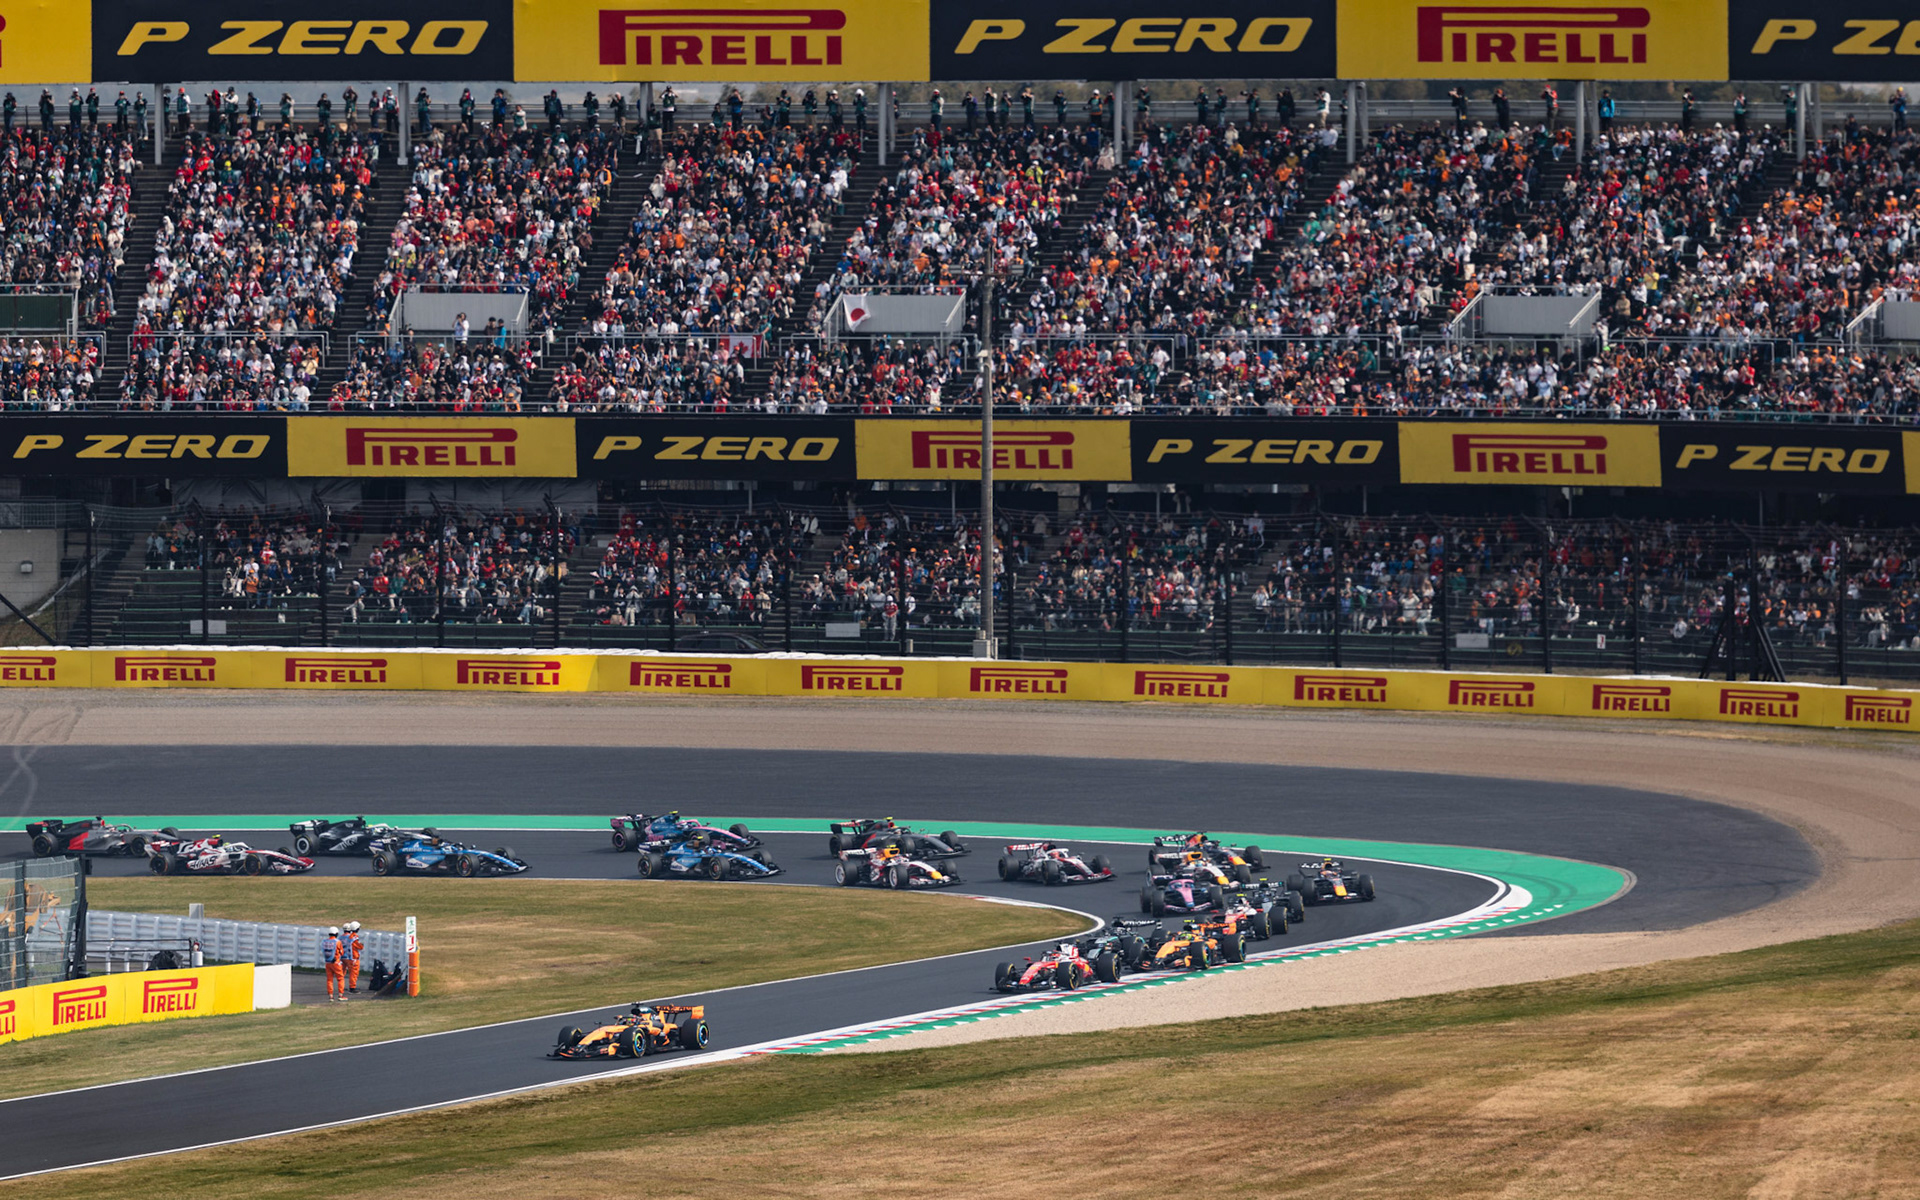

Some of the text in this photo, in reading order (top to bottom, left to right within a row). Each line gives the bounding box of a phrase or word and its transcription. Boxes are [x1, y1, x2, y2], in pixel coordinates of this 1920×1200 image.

[117, 20, 490, 57] P ZERO
[599, 10, 847, 66] PIRELLI
[954, 17, 1314, 55] P ZERO
[1417, 6, 1650, 64] PIRELLI
[1751, 19, 1818, 55] P
[13, 435, 271, 460] P ZERO
[346, 428, 519, 467] PIRELLI
[593, 437, 840, 462] P ZERO
[911, 431, 1076, 470] PIRELLI
[1147, 440, 1384, 465] P ZERO
[1452, 433, 1608, 474] PIRELLI
[1676, 445, 1891, 474] P ZERO
[115, 657, 217, 683] PIRELLI
[285, 658, 388, 683] PIRELLI
[457, 660, 561, 686] PIRELLI
[630, 662, 733, 689] PIRELLI
[801, 665, 904, 691] PIRELLI
[970, 667, 1069, 694] PIRELLI
[1135, 671, 1230, 699] PIRELLI
[1294, 675, 1388, 703] PIRELLI
[1448, 680, 1536, 707] PIRELLI
[1592, 685, 1671, 713] PIRELLI
[1719, 689, 1799, 718] PIRELLI
[1845, 695, 1913, 724] PIRELLI
[52, 986, 107, 1026] PIRELLI
[143, 977, 199, 1014] PIRELLI
